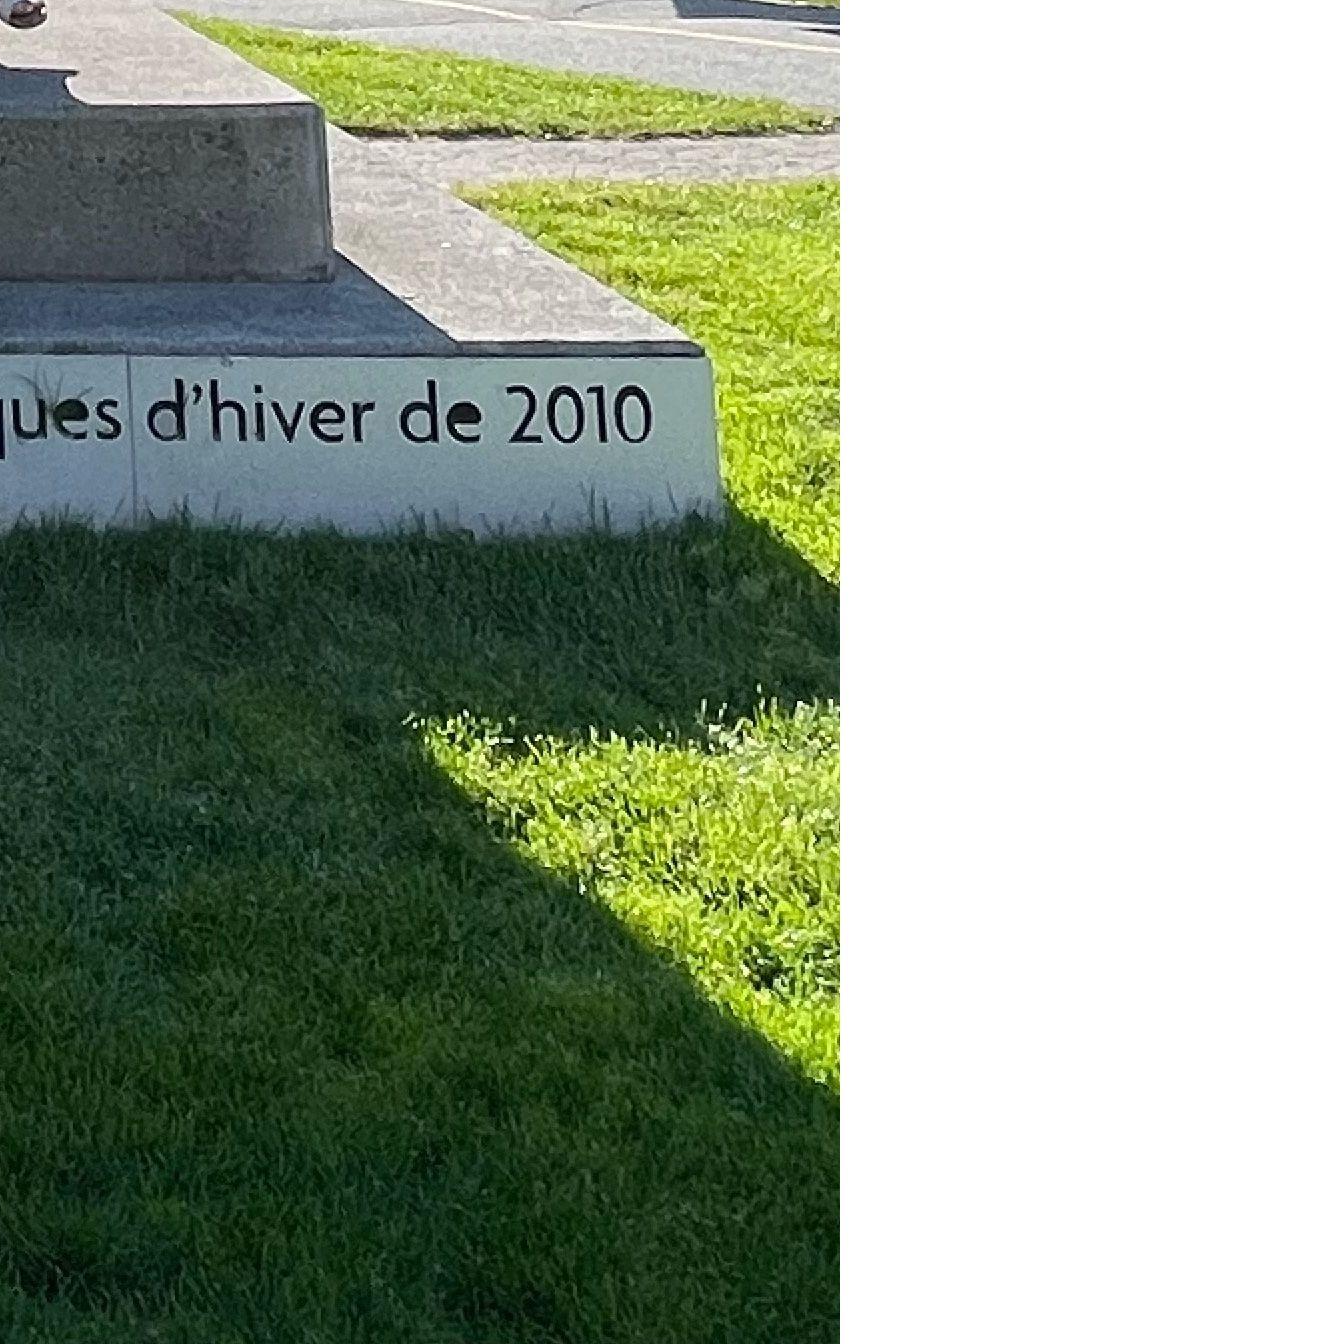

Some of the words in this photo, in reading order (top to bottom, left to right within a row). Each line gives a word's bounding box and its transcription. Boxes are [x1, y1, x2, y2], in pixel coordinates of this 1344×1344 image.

[147, 378, 376, 444] d'hiver
[400, 379, 482, 444] de
[506, 384, 652, 444] 2010
